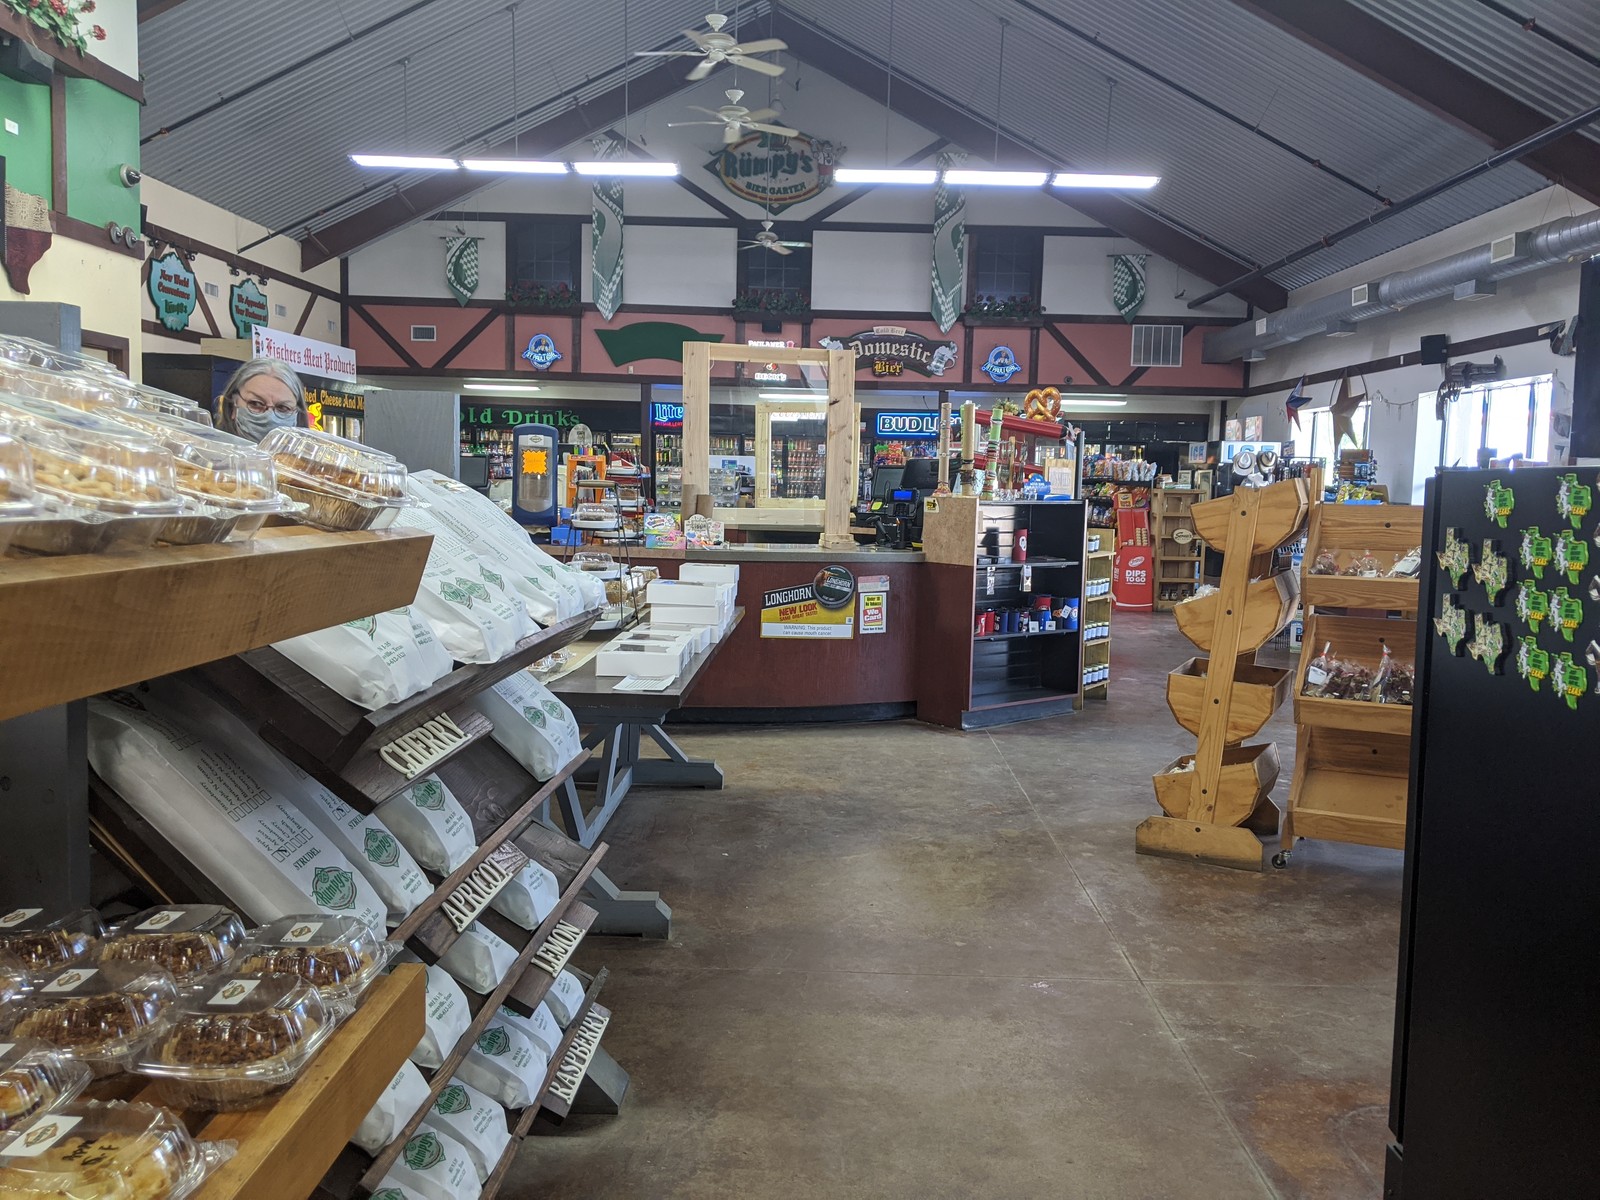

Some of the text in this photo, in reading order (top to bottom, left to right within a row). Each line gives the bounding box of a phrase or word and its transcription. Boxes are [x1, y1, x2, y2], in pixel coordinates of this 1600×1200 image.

[722, 150, 813, 178] Rümpy's
[266, 338, 355, 375] Fischers Meat Products
[849, 340, 931, 363] Domestic
[875, 361, 903, 373] Bier
[320, 389, 342, 407] Cheese
[344, 394, 356, 409] And
[501, 410, 580, 426] Drinks
[655, 404, 684, 422] Lite
[880, 416, 922, 432] BUD
[765, 587, 812, 606] LONGHORN
[779, 603, 817, 616] NEW LOOK
[379, 712, 472, 779] CHERRY
[293, 847, 321, 870] STRUDEL
[315, 869, 350, 905] Rümpy's
[441, 857, 513, 933] APRICOT
[531, 919, 586, 978] LEMON
[549, 1006, 610, 1105] RASPBERRY
[406, 1132, 438, 1168] Rümpy's
